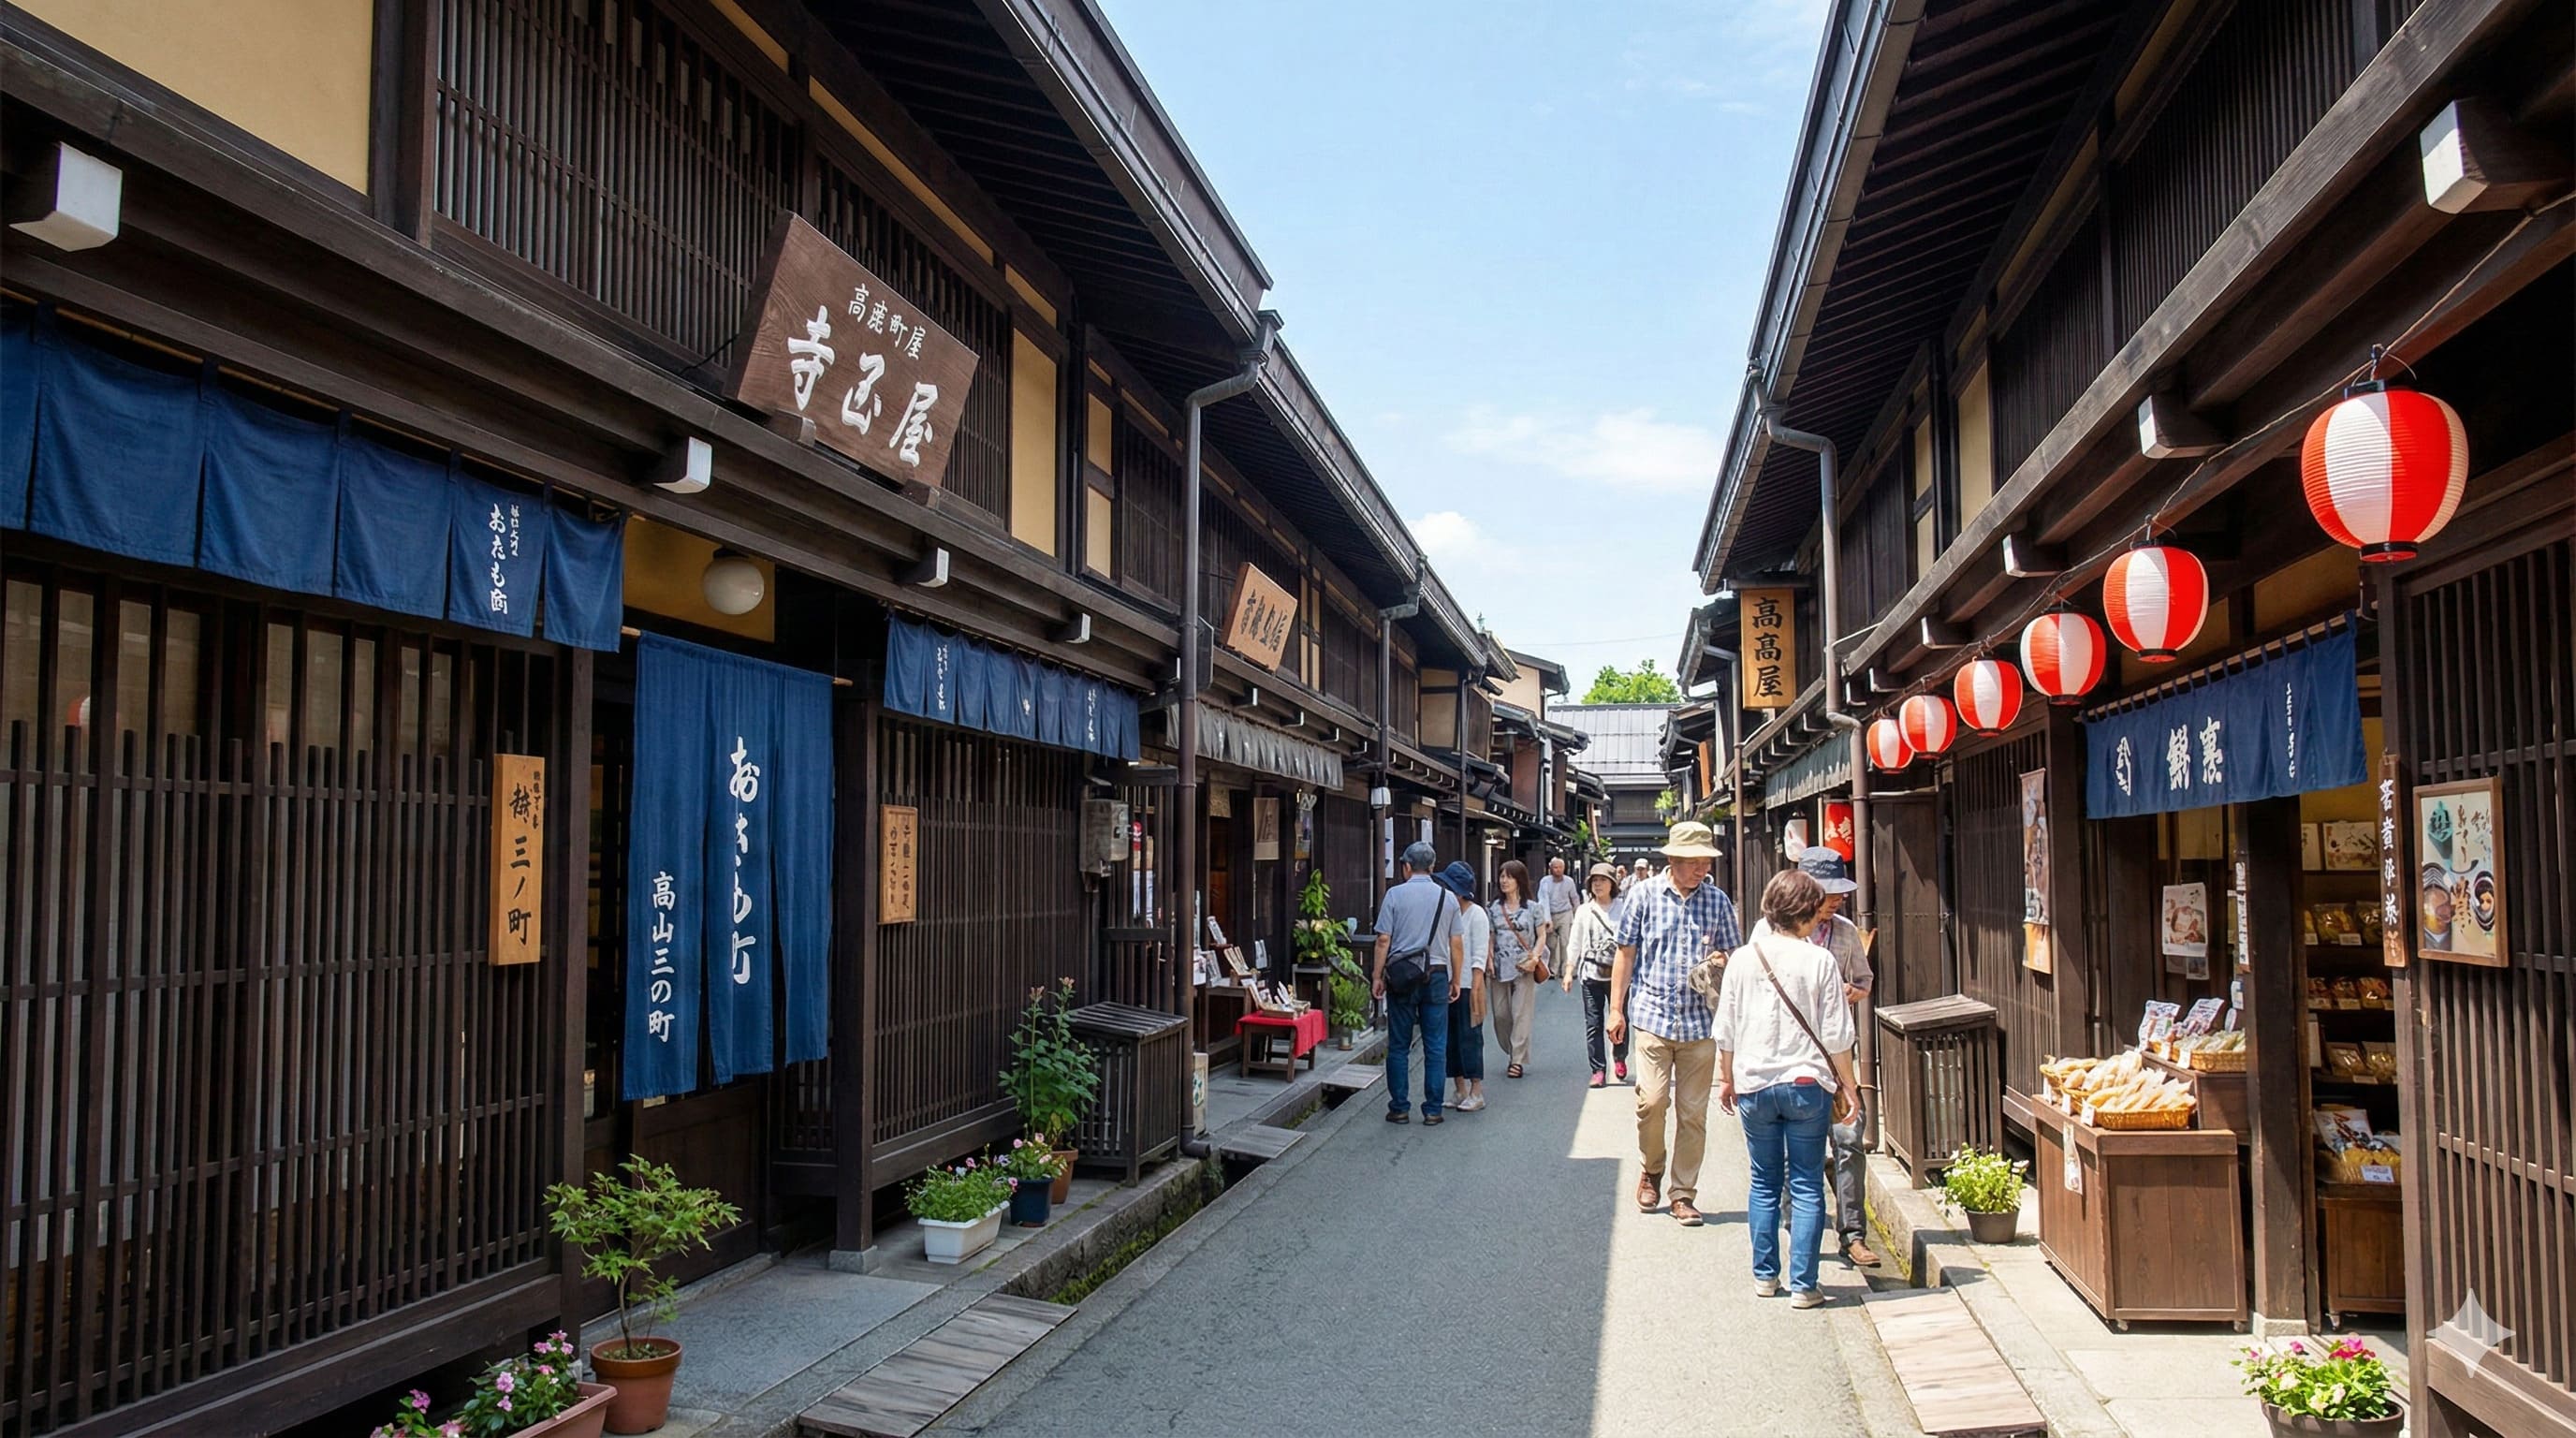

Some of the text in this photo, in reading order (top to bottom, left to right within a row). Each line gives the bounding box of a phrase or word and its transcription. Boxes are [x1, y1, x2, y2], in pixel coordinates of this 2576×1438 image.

[1751, 597, 1783, 697] 高高屋
[648, 871, 676, 1043] 高山三の町
